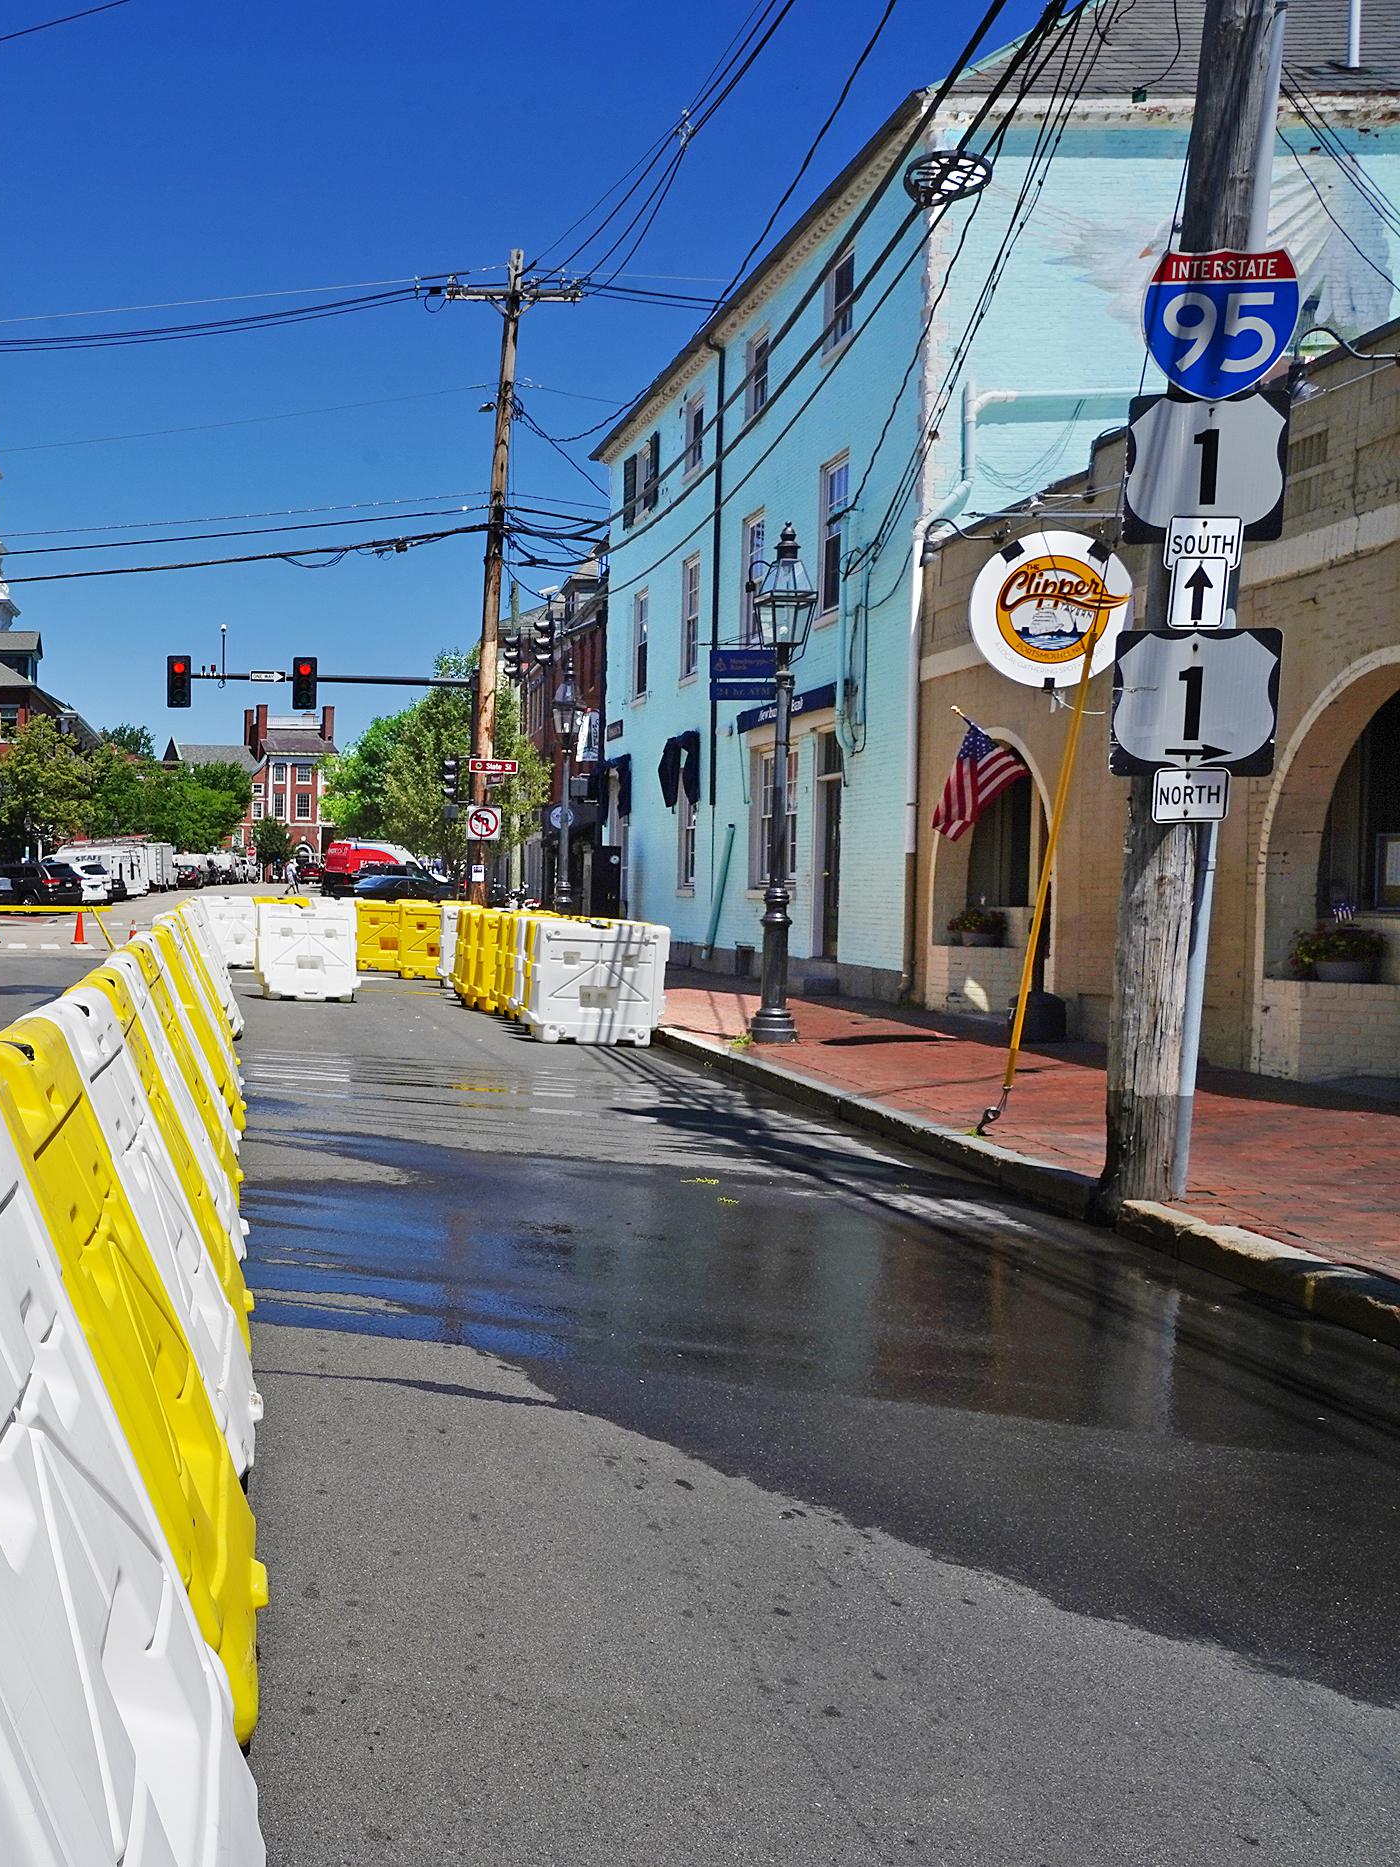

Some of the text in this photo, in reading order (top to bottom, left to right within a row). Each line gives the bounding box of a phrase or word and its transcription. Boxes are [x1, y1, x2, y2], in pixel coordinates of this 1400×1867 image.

[1171, 258, 1278, 279] INTERSTATE
[1163, 292, 1276, 373] 95
[1194, 429, 1220, 505] 1
[1171, 535, 1235, 555] SOUTH
[1026, 563, 1040, 571] THE
[1000, 570, 1108, 612] Clipper
[1060, 602, 1093, 619] TAVERN
[1179, 666, 1203, 741] 1
[505, 763, 512, 771] St
[1159, 785, 1221, 806] NORTH
